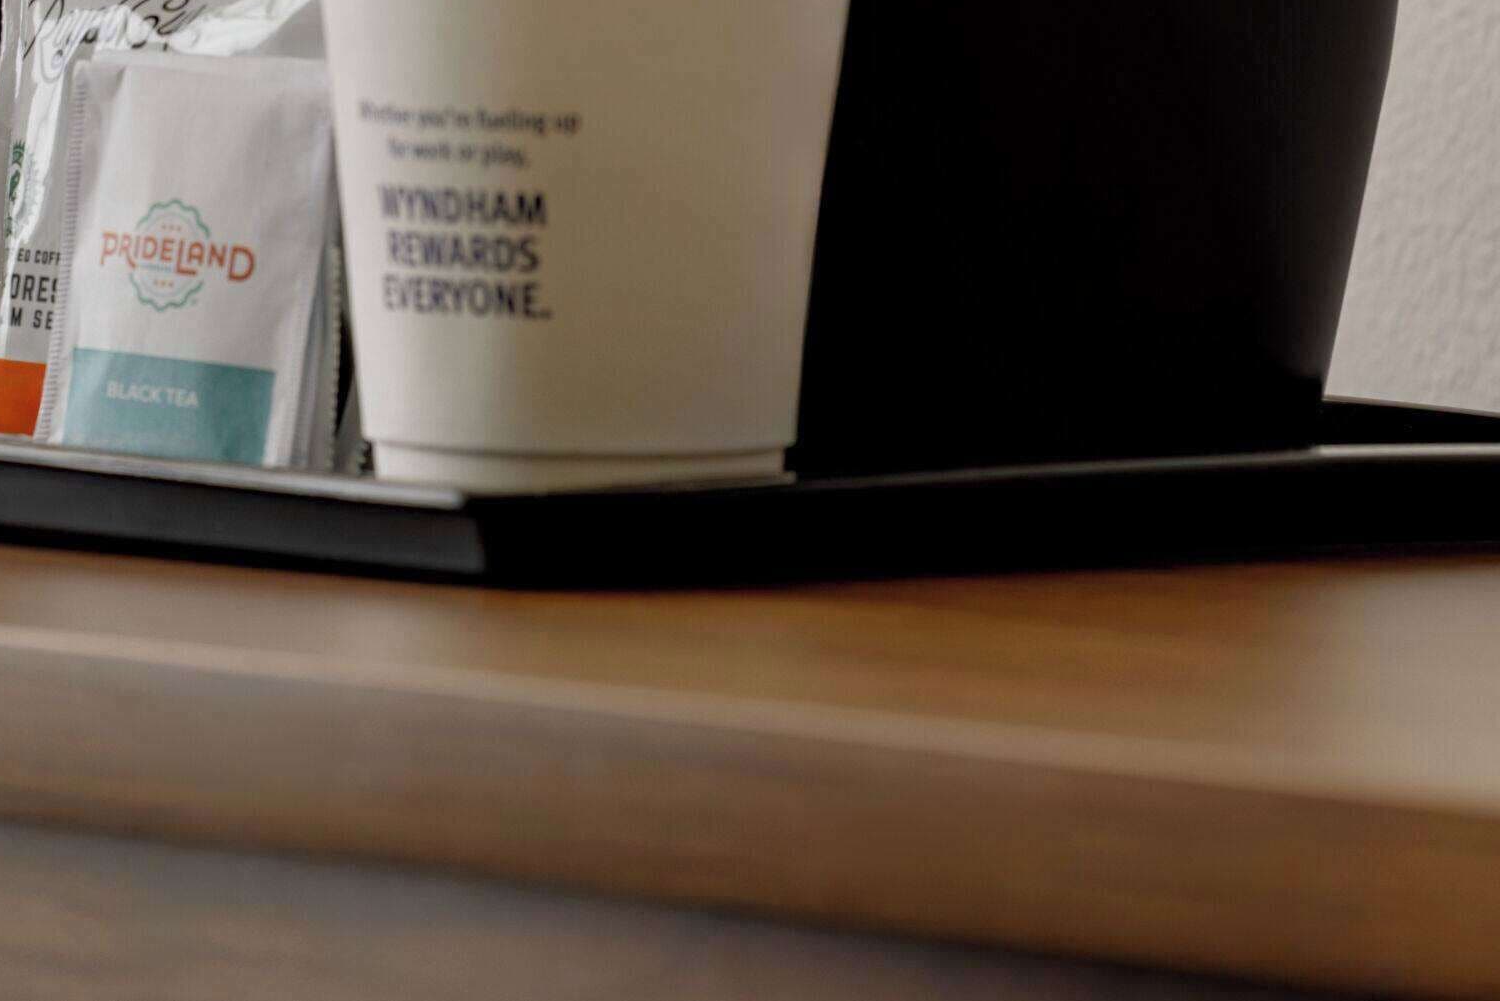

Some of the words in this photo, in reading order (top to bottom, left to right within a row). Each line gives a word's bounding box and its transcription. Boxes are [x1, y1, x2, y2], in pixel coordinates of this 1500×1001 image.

[380, 185, 546, 224] WYNDHAM
[100, 232, 257, 281] PRIDELAND
[389, 231, 539, 272] REWARDS
[383, 274, 553, 320] EVERYONE.
[106, 380, 161, 403] BLACK
[165, 387, 199, 407] TEA
